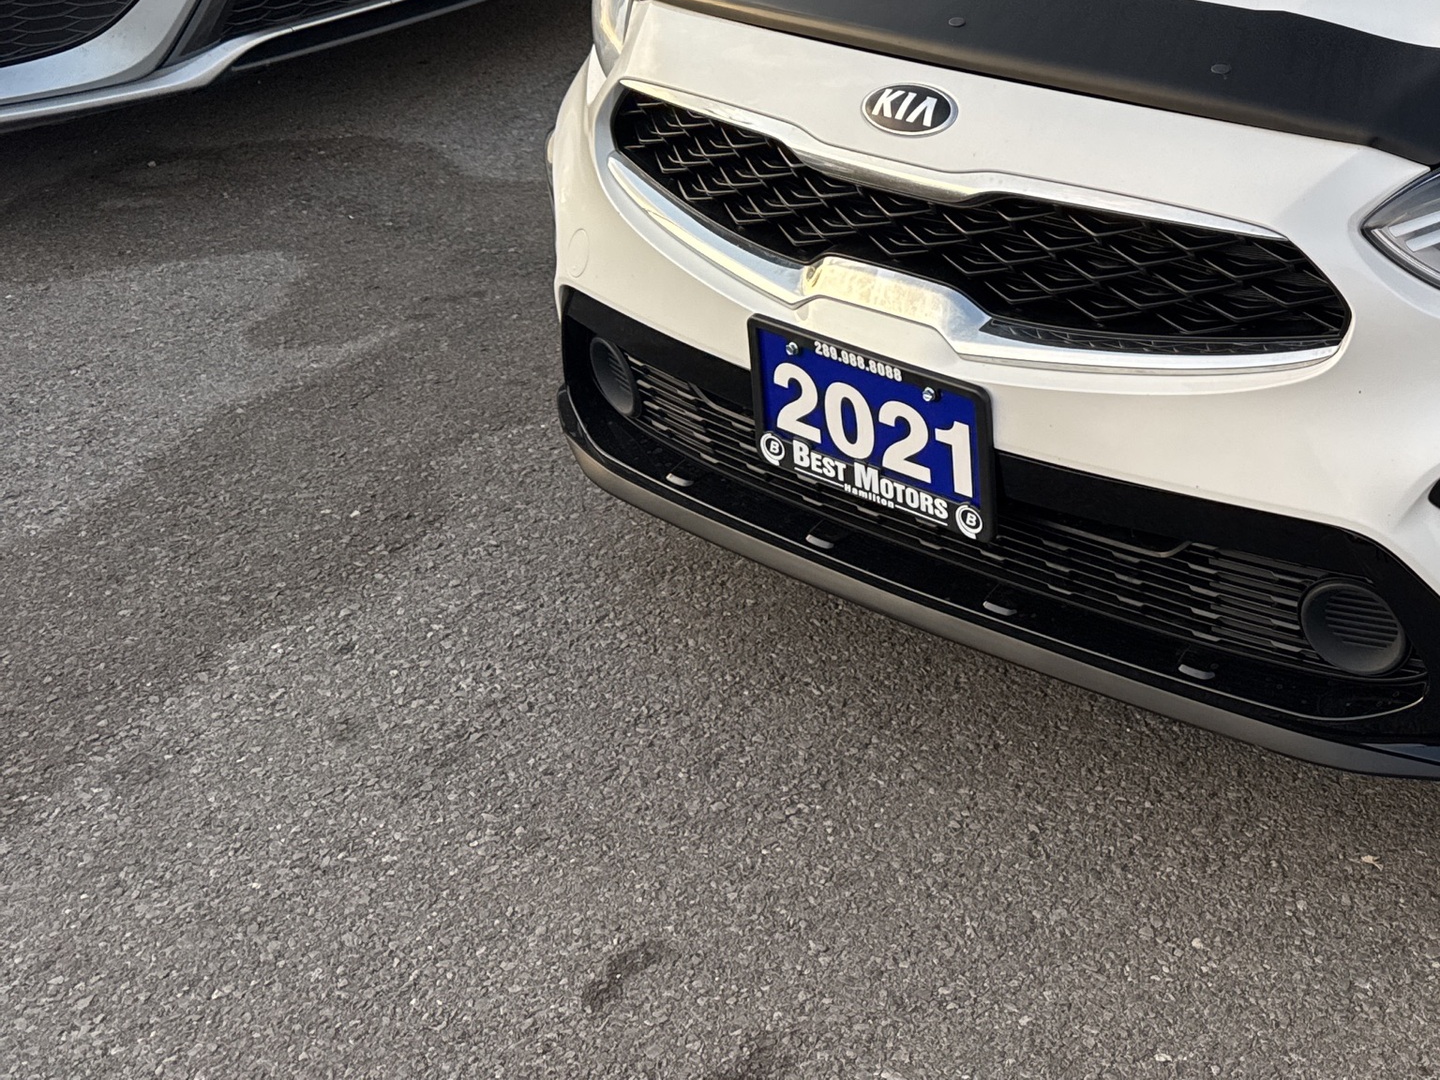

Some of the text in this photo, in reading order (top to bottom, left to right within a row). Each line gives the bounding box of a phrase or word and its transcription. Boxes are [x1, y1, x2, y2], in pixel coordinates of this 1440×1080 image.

[871, 88, 938, 127] KIA
[814, 341, 902, 382] 289.988.8088
[773, 362, 974, 498] 2021
[792, 439, 949, 520] BEST MOTORS
[844, 483, 895, 508] Hamilton
